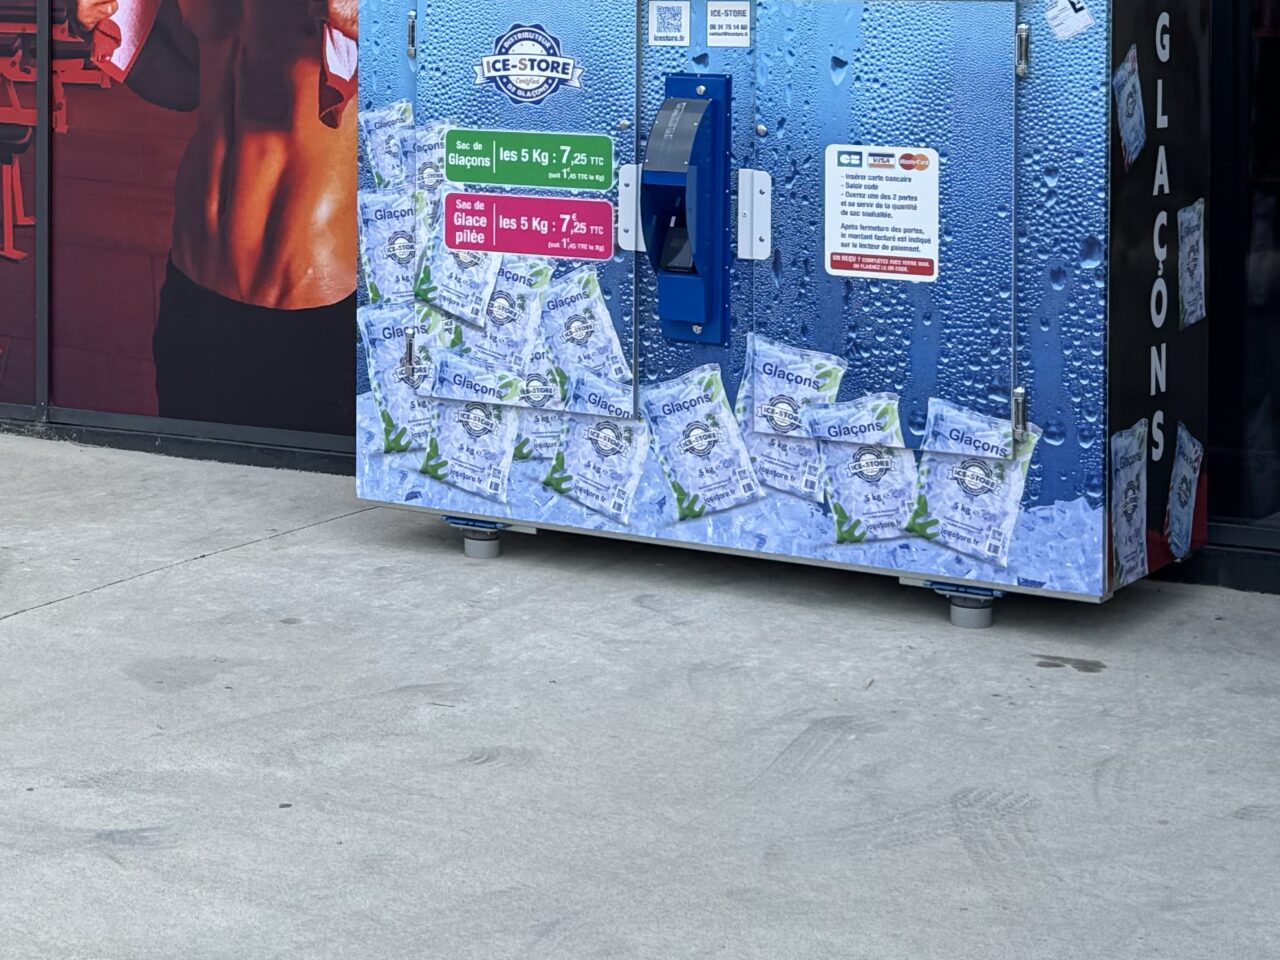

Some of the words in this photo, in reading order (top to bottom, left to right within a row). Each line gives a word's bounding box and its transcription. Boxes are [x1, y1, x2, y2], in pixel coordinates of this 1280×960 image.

[710, 9, 748, 17] ICE-STORE
[503, 31, 552, 49] DISTRIBUTEUR
[486, 58, 571, 76] ICE-STORE
[456, 140, 470, 150] Sac
[473, 141, 483, 151] de
[448, 153, 491, 169] Glaçons
[499, 147, 518, 162] les
[521, 148, 529, 162] 5
[532, 148, 549, 166] Kg
[590, 156, 605, 166] TTC
[474, 200, 485, 210] de
[374, 208, 415, 221] Glaçon
[454, 212, 487, 227] Glace
[499, 215, 518, 229] les
[521, 217, 529, 230] 5
[532, 217, 549, 235] Kg
[590, 226, 605, 235] TTC
[455, 230, 485, 245] pilée
[498, 267, 535, 288] açons
[547, 290, 590, 311] Glaçons
[762, 362, 820, 390] Glaçons
[453, 373, 503, 399] Glaçons
[662, 393, 711, 416] Glaçons
[763, 406, 800, 422] ICE-STOR
[827, 422, 883, 438] Glaçons
[949, 428, 1008, 457] Glaçons
[851, 460, 890, 470] ICE-STORE
[954, 469, 996, 488] ICE-STORE
